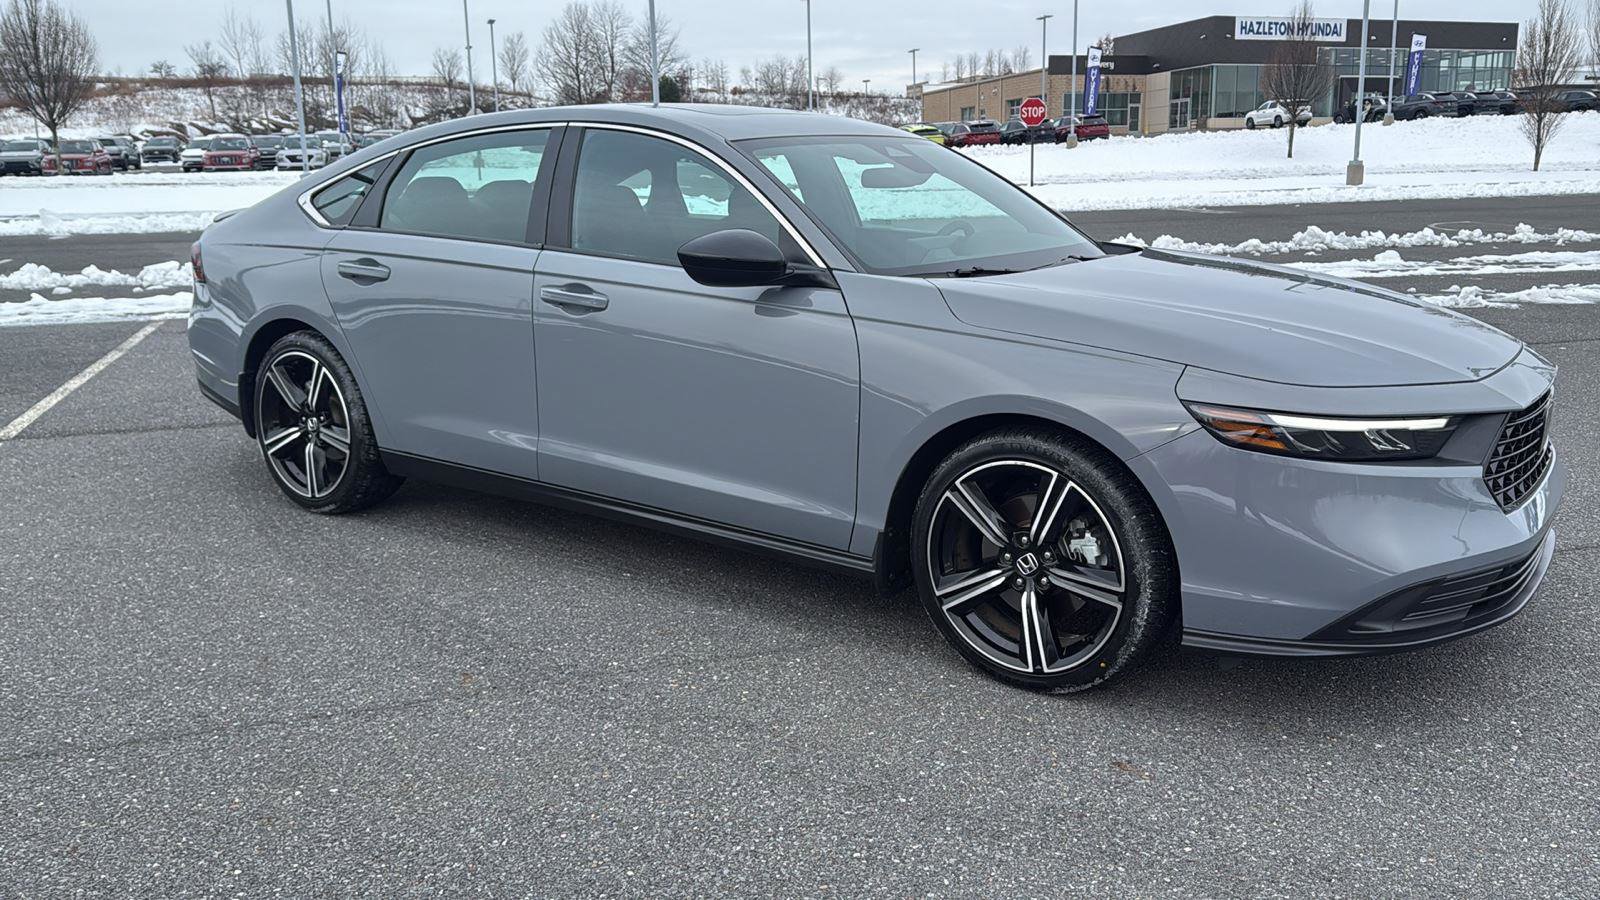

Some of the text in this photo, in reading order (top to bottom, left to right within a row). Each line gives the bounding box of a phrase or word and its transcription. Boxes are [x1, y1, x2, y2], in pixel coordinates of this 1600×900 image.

[1240, 20, 1342, 37] HAZLETON HYUNDAI
[1021, 106, 1045, 118] STOP
